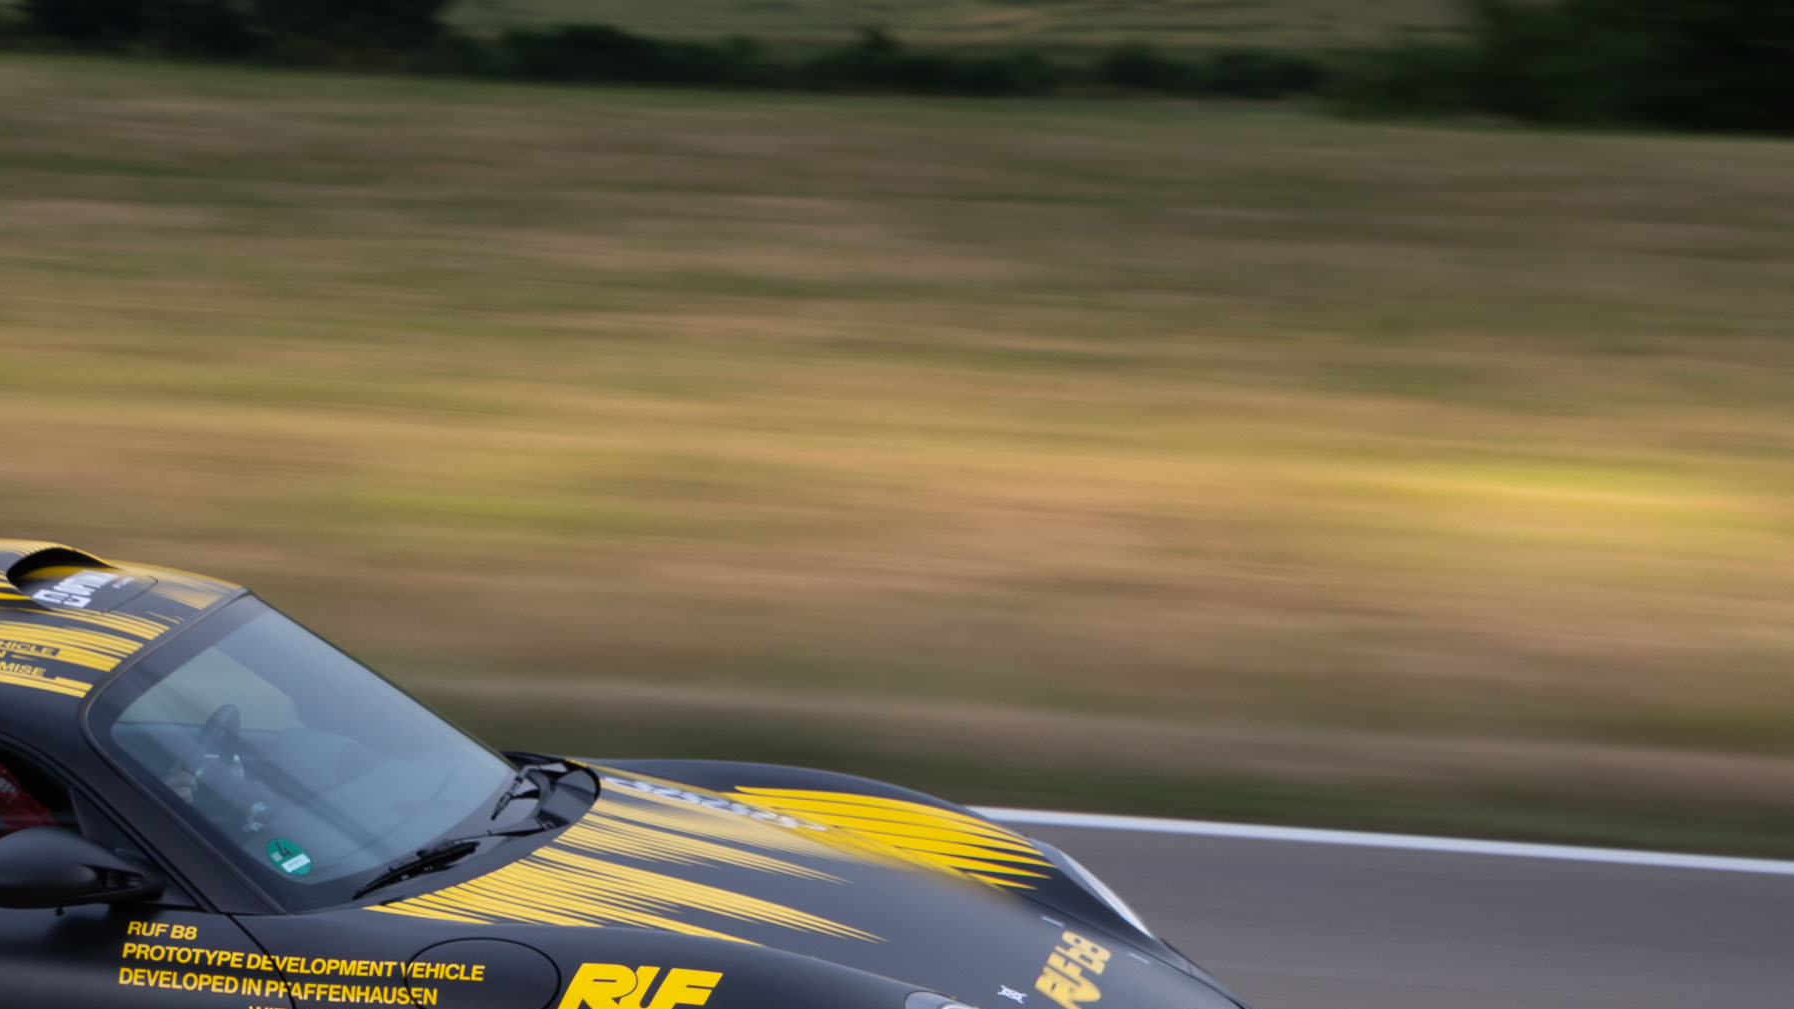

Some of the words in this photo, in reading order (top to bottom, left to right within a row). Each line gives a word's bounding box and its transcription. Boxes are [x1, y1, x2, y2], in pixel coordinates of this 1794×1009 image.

[275, 841, 293, 857] 4
[127, 920, 169, 938] RUF
[170, 924, 198, 941] B8
[121, 942, 244, 968] PROTOTYPE
[246, 953, 397, 978] DEVELOPMENT
[400, 962, 485, 982] VEHICLE
[118, 967, 238, 995] DEVELOPED
[242, 978, 262, 996] IN
[264, 980, 438, 1006] PFAFFENHAUSEN
